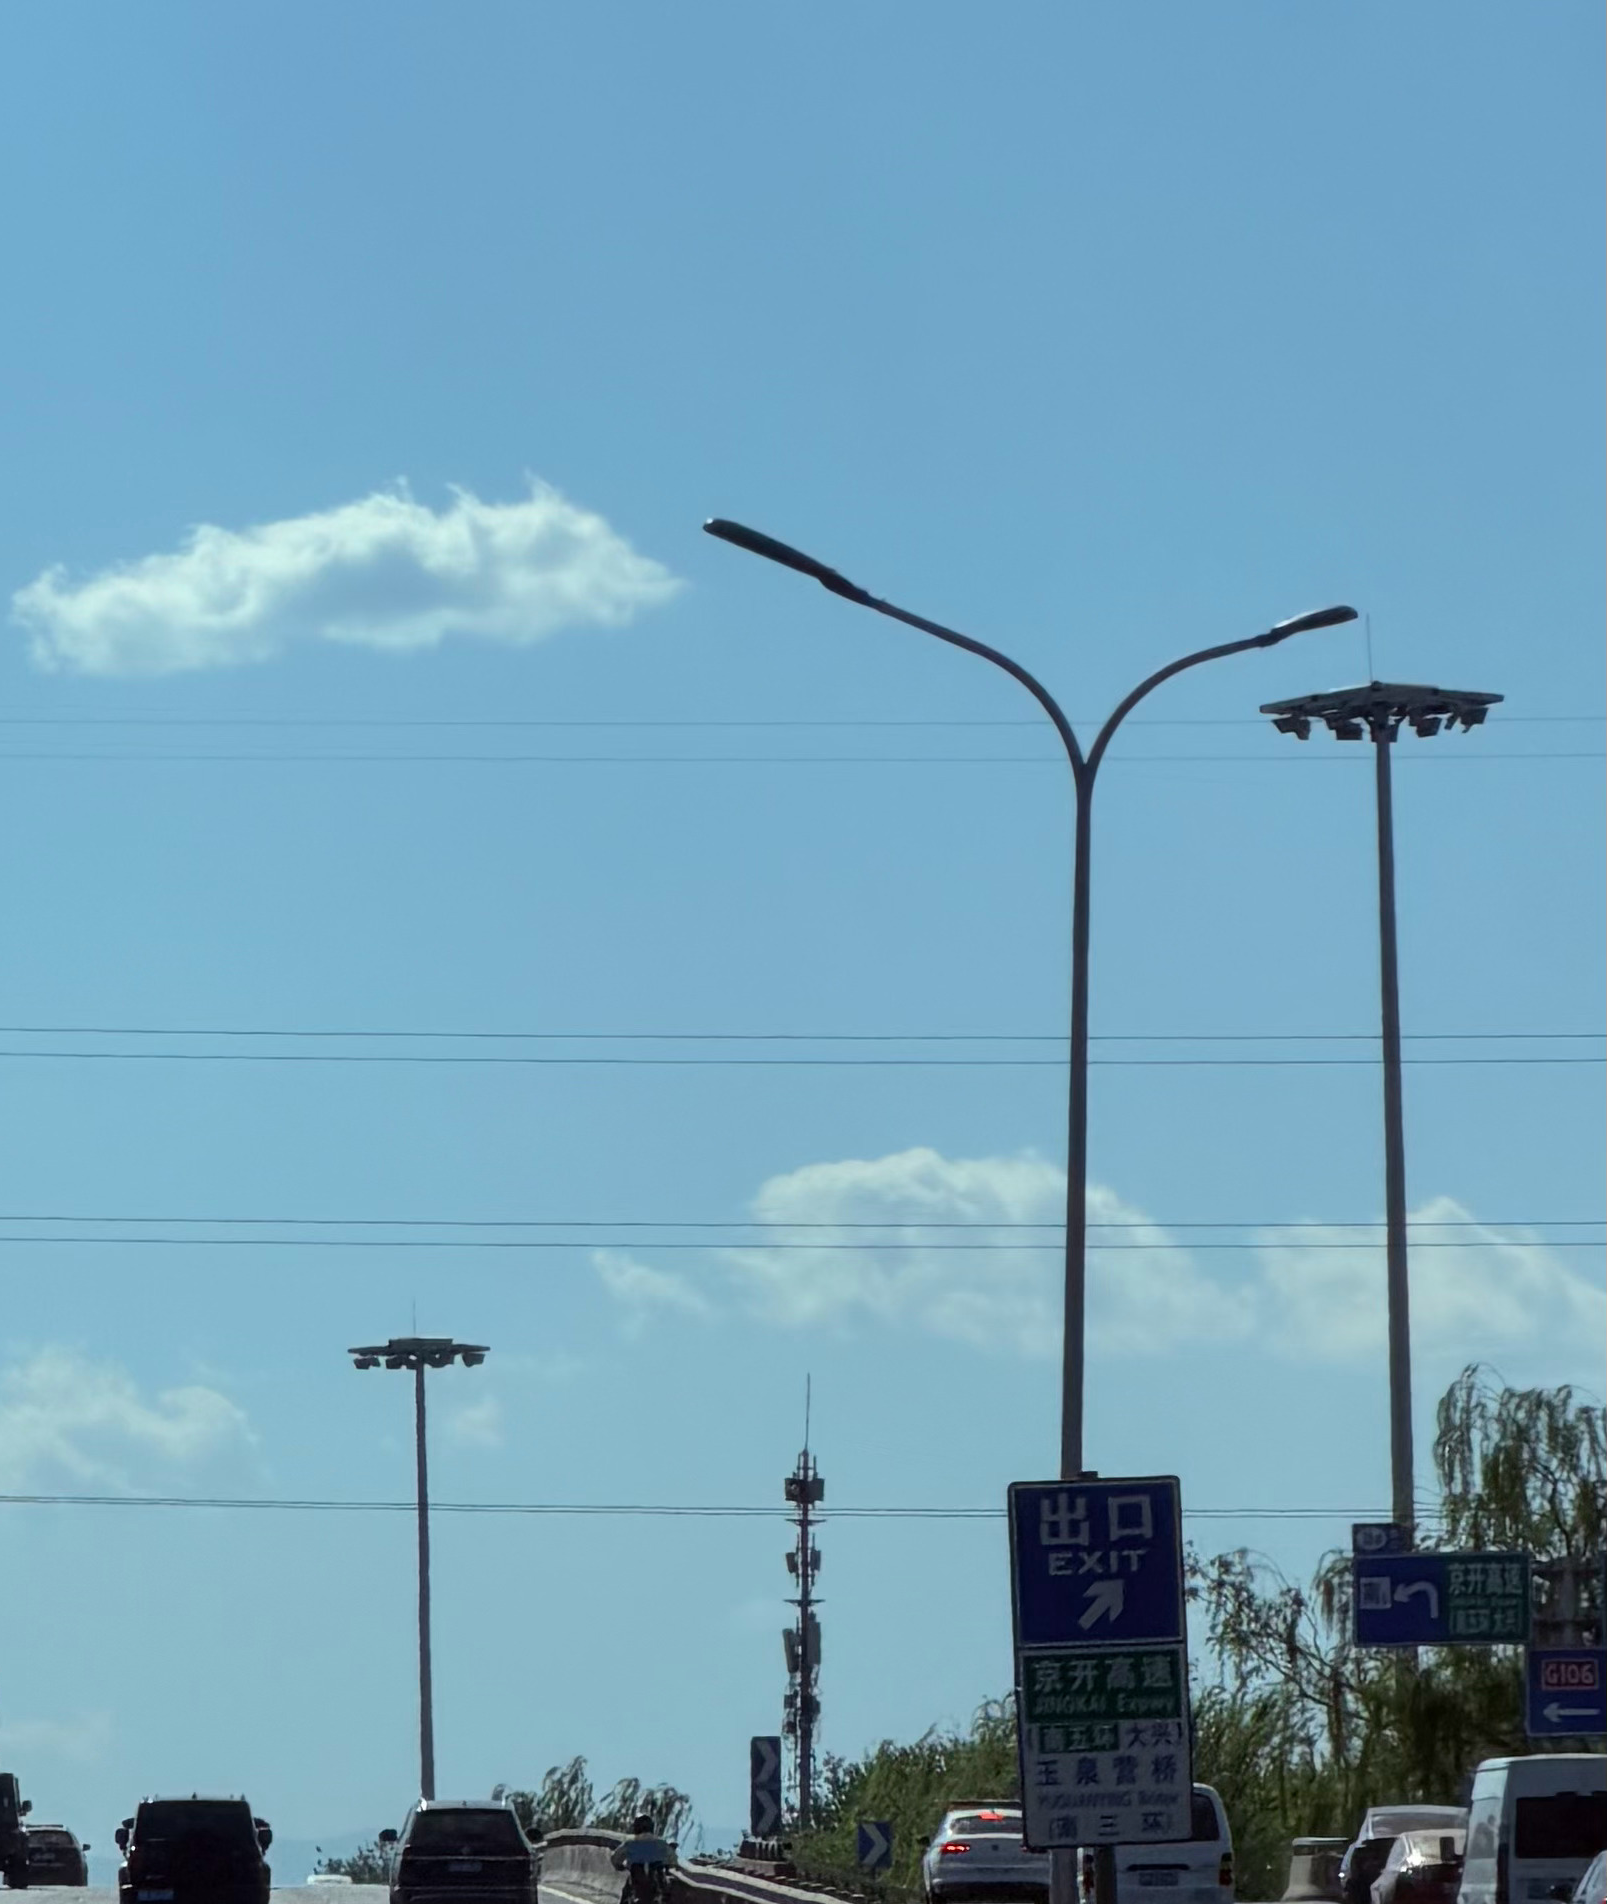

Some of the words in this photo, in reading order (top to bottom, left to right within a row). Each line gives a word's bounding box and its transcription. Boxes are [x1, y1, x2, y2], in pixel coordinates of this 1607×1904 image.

[1040, 1493, 1154, 1546] 出口
[1048, 1548, 1148, 1576] EXIT
[1448, 1562, 1523, 1596] 京开高速
[1033, 1655, 1173, 1692] 京开高速
[1545, 1664, 1594, 1685] G106
[1035, 1754, 1177, 1786] 玉泉营桥
